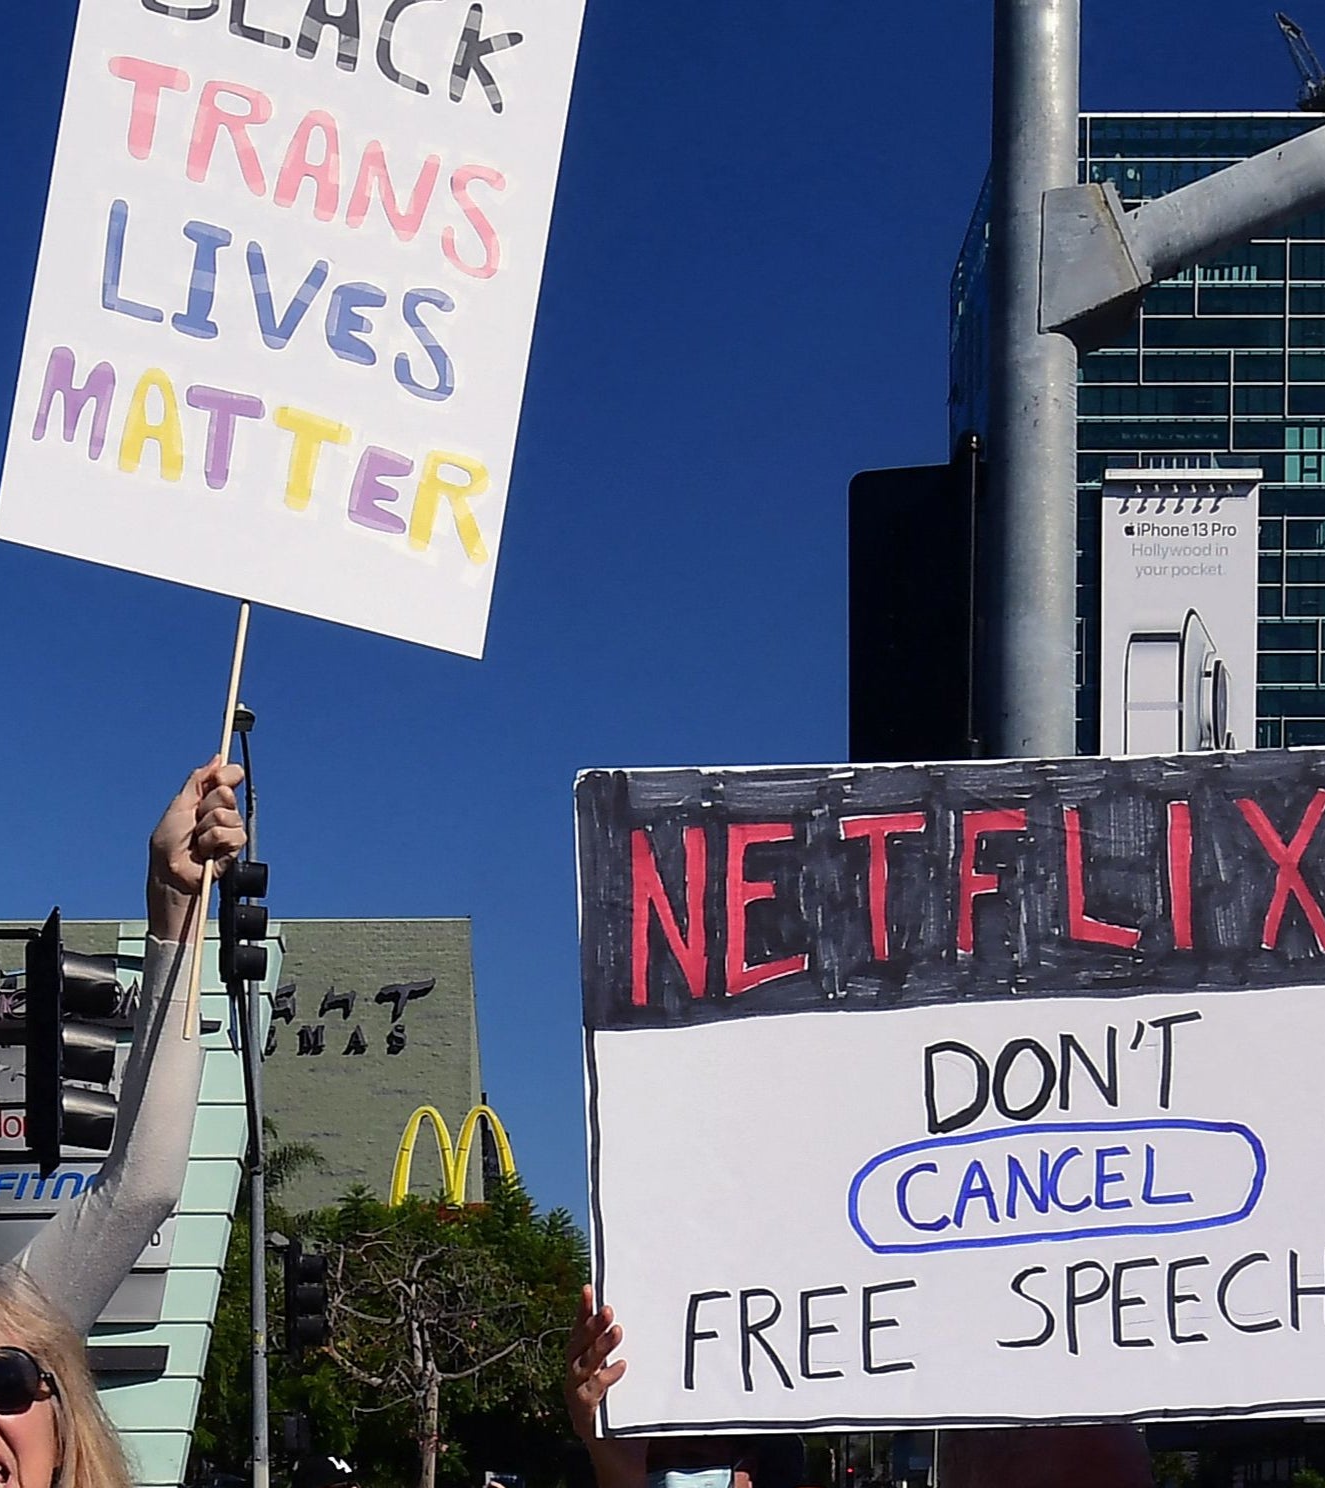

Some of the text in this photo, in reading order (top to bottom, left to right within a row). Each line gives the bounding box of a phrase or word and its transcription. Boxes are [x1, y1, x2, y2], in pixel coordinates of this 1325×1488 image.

[140, 0, 524, 115] LACK
[108, 56, 507, 279] TRANS
[101, 199, 455, 402] LIVES
[32, 345, 492, 565] MATTER
[1131, 543, 1229, 559] Hollywood in
[1135, 564, 1168, 578] your
[1137, 522, 1237, 537] iPhone 13 Pro
[923, 1011, 1201, 1135] DON'T
[896, 1143, 1194, 1232] CANCEL
[682, 1280, 916, 1391] FREE
